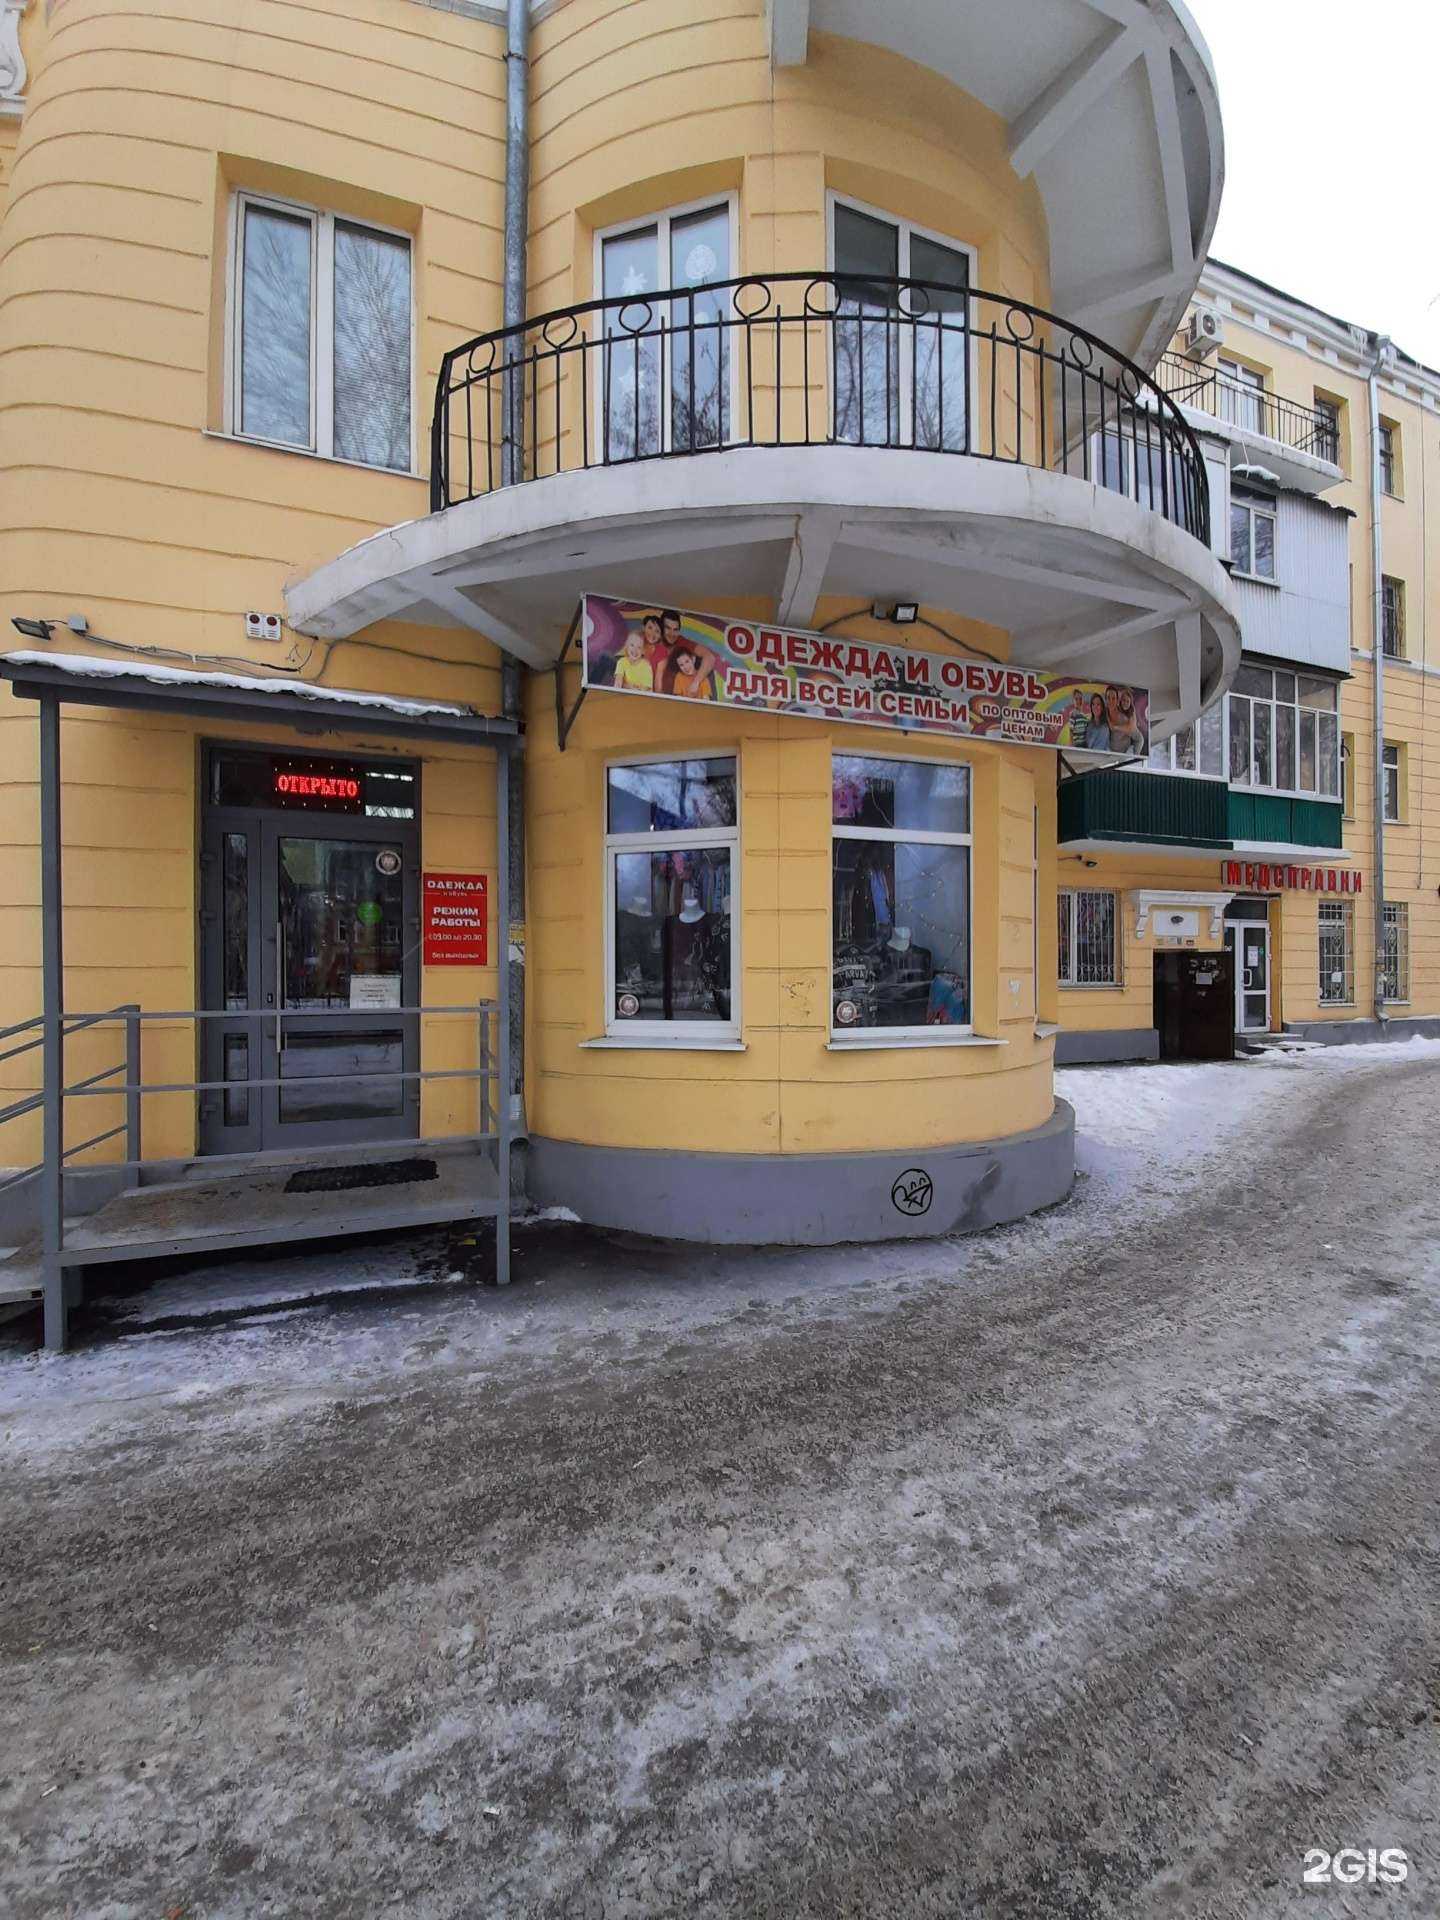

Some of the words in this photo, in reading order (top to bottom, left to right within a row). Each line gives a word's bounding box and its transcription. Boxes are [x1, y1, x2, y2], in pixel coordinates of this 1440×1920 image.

[727, 627, 896, 679] ОДЕЖДА
[907, 656, 929, 683] И
[940, 662, 1047, 700] ОБУВЬ
[727, 671, 788, 698] ДЛЯ
[799, 681, 871, 710] ВСЕЙ
[880, 693, 968, 723] СЕМЬИ
[982, 704, 1001, 717] ПО
[1003, 706, 1063, 726] ОПТОВЫМ
[1002, 723, 1043, 737] ЦЕНАМ
[278, 774, 358, 797] ОТКРЫТО
[427, 880, 484, 890] ОДЕЖДА
[433, 906, 479, 916] РЕЖИМ
[431, 918, 480, 927] РАБОТЫ
